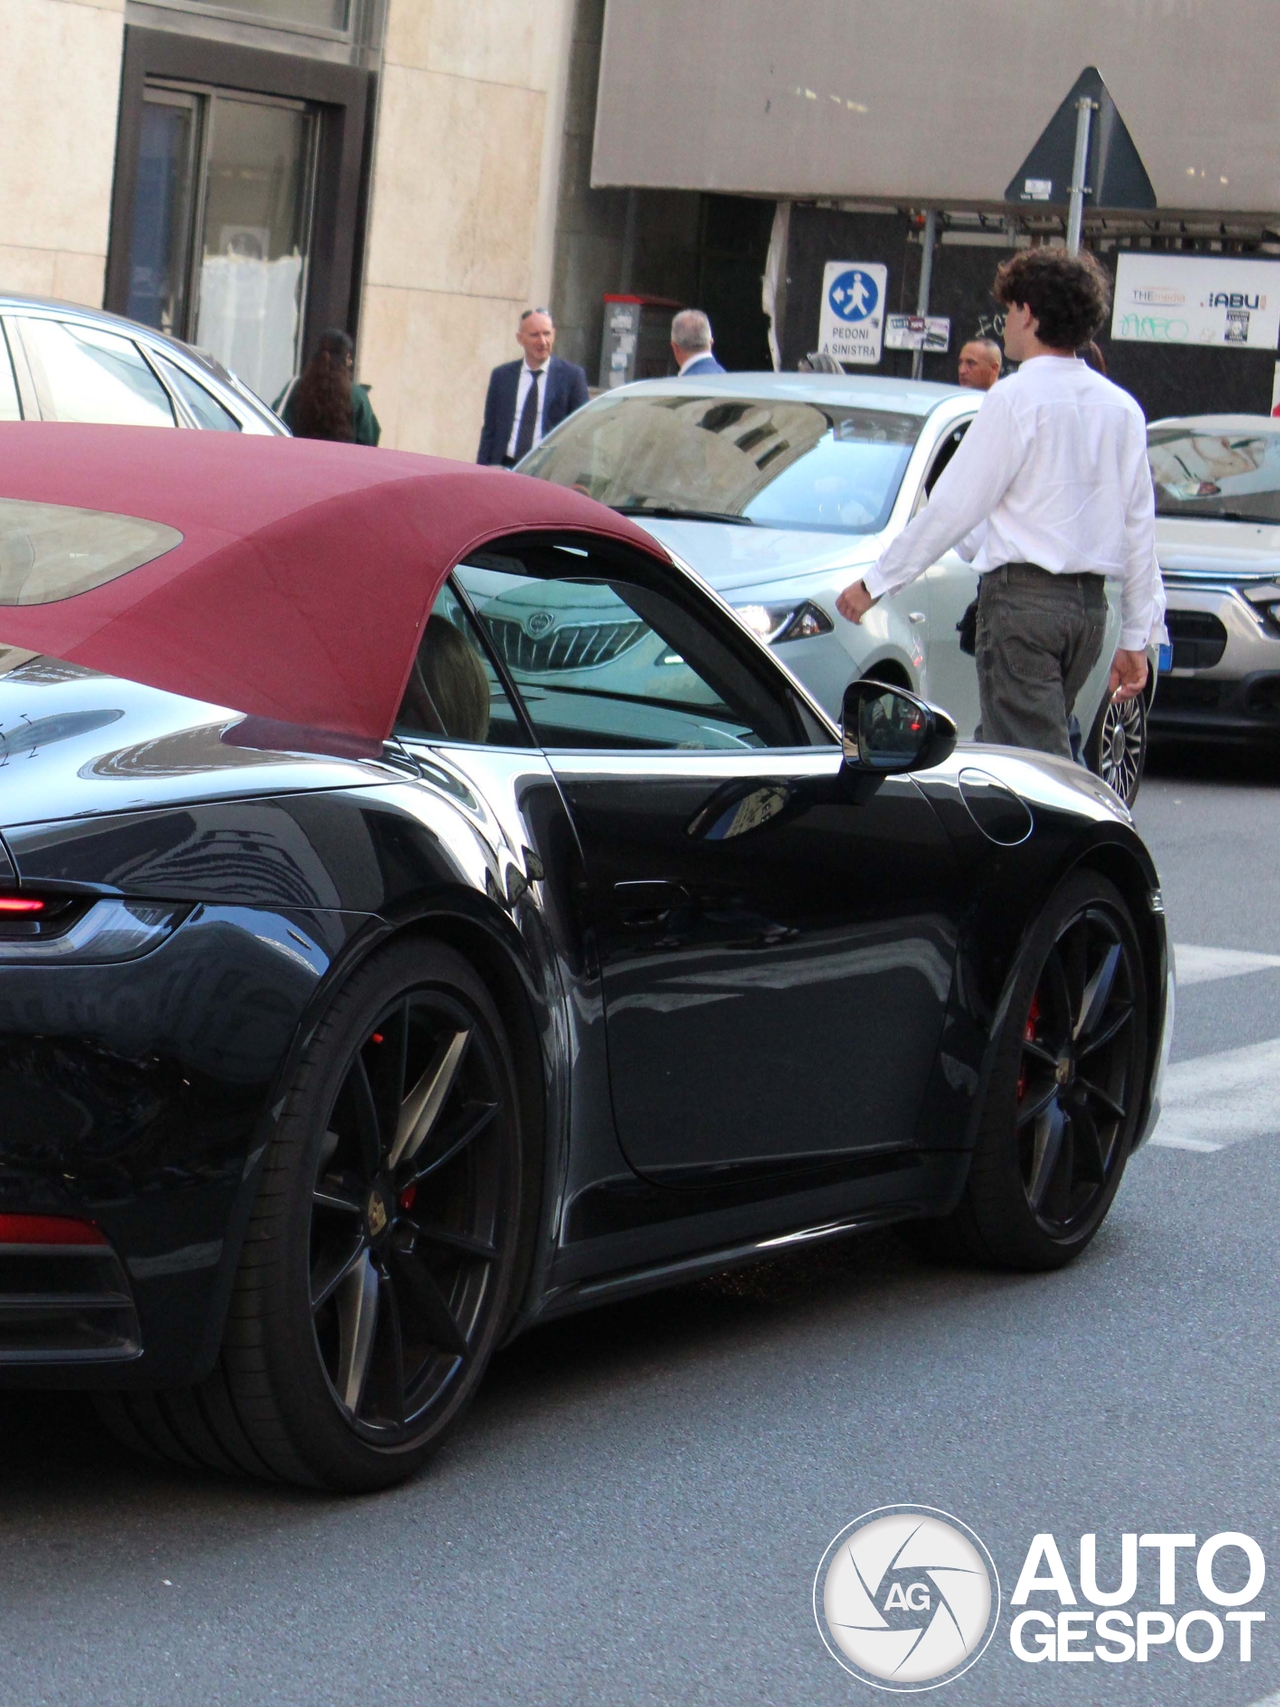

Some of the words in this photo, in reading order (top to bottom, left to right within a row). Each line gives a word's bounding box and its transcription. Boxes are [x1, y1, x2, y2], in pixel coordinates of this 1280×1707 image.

[832, 327, 869, 339] PEDONI
[823, 343, 830, 354] A
[832, 344, 876, 358] SINISTRA
